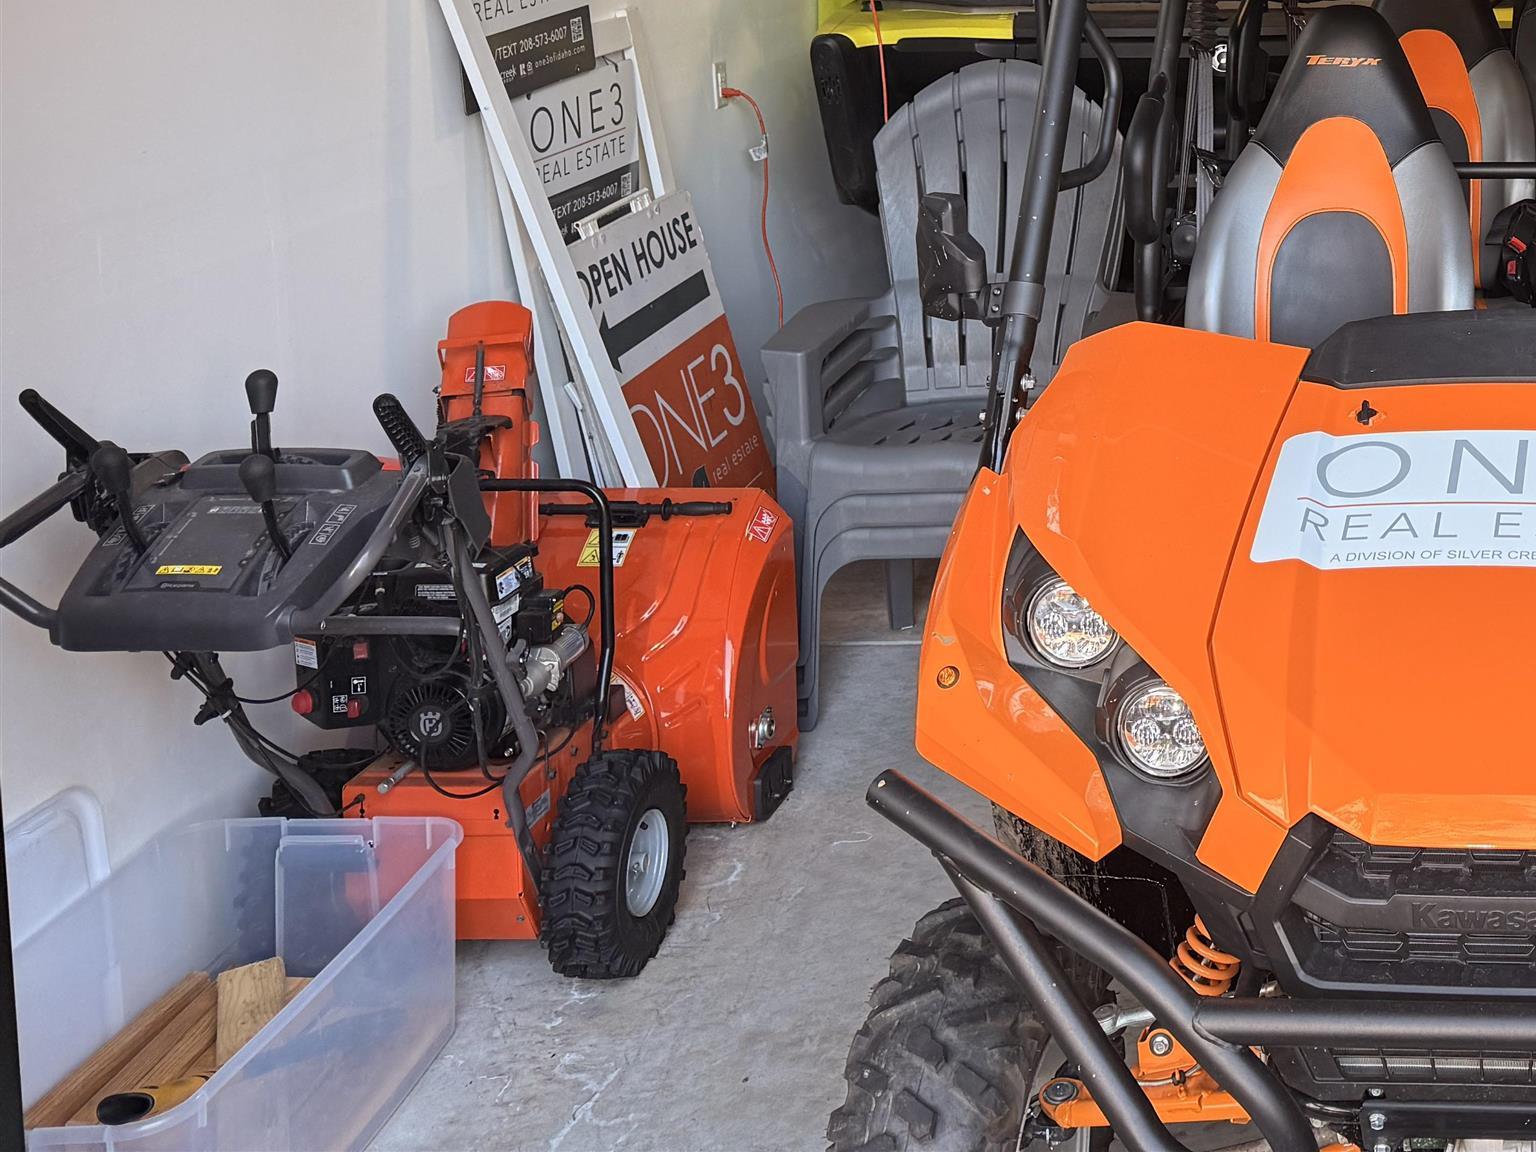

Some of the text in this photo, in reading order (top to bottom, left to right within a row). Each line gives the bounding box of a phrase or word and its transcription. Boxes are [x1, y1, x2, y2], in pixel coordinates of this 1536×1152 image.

[520, 26, 568, 54] 208-573-6007
[530, 83, 625, 153] ONE3
[536, 135, 626, 184] EAL ESTATE
[573, 182, 618, 212] 208-573-6007
[631, 211, 697, 279] HOUSE
[713, 434, 760, 484] real estate
[1300, 507, 1458, 541] REAL
[1330, 553, 1341, 563] A
[1345, 550, 1416, 562] DIVISION
[1420, 550, 1442, 560] OF
[1447, 549, 1503, 559] SILVER
